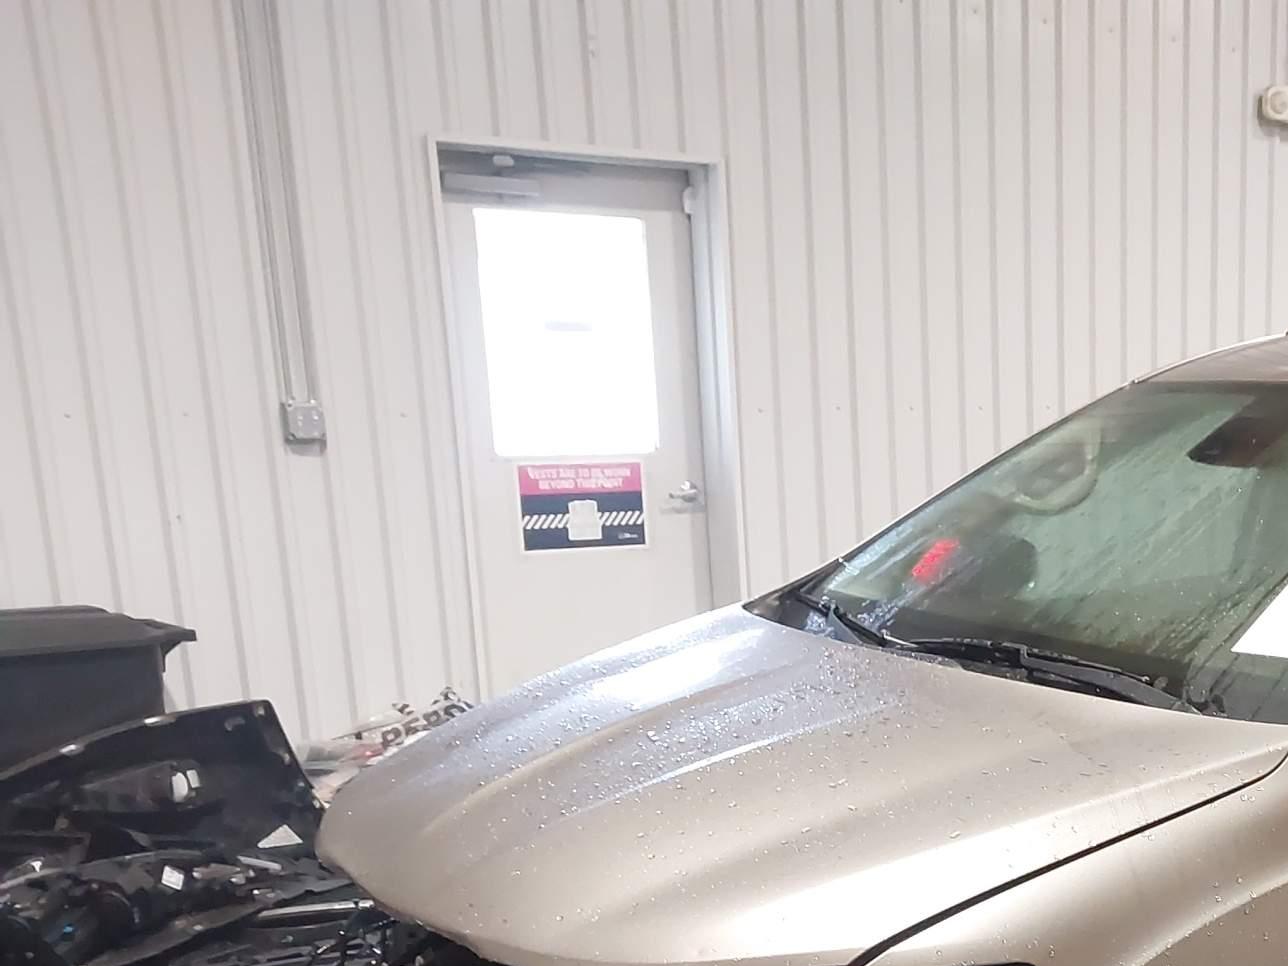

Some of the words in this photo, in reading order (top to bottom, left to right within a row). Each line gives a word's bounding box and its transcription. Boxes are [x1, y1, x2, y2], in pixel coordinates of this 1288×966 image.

[527, 467, 557, 480] VESTS
[559, 468, 576, 479] ARE
[578, 468, 590, 478] TO
[538, 479, 575, 490] BEYOND
